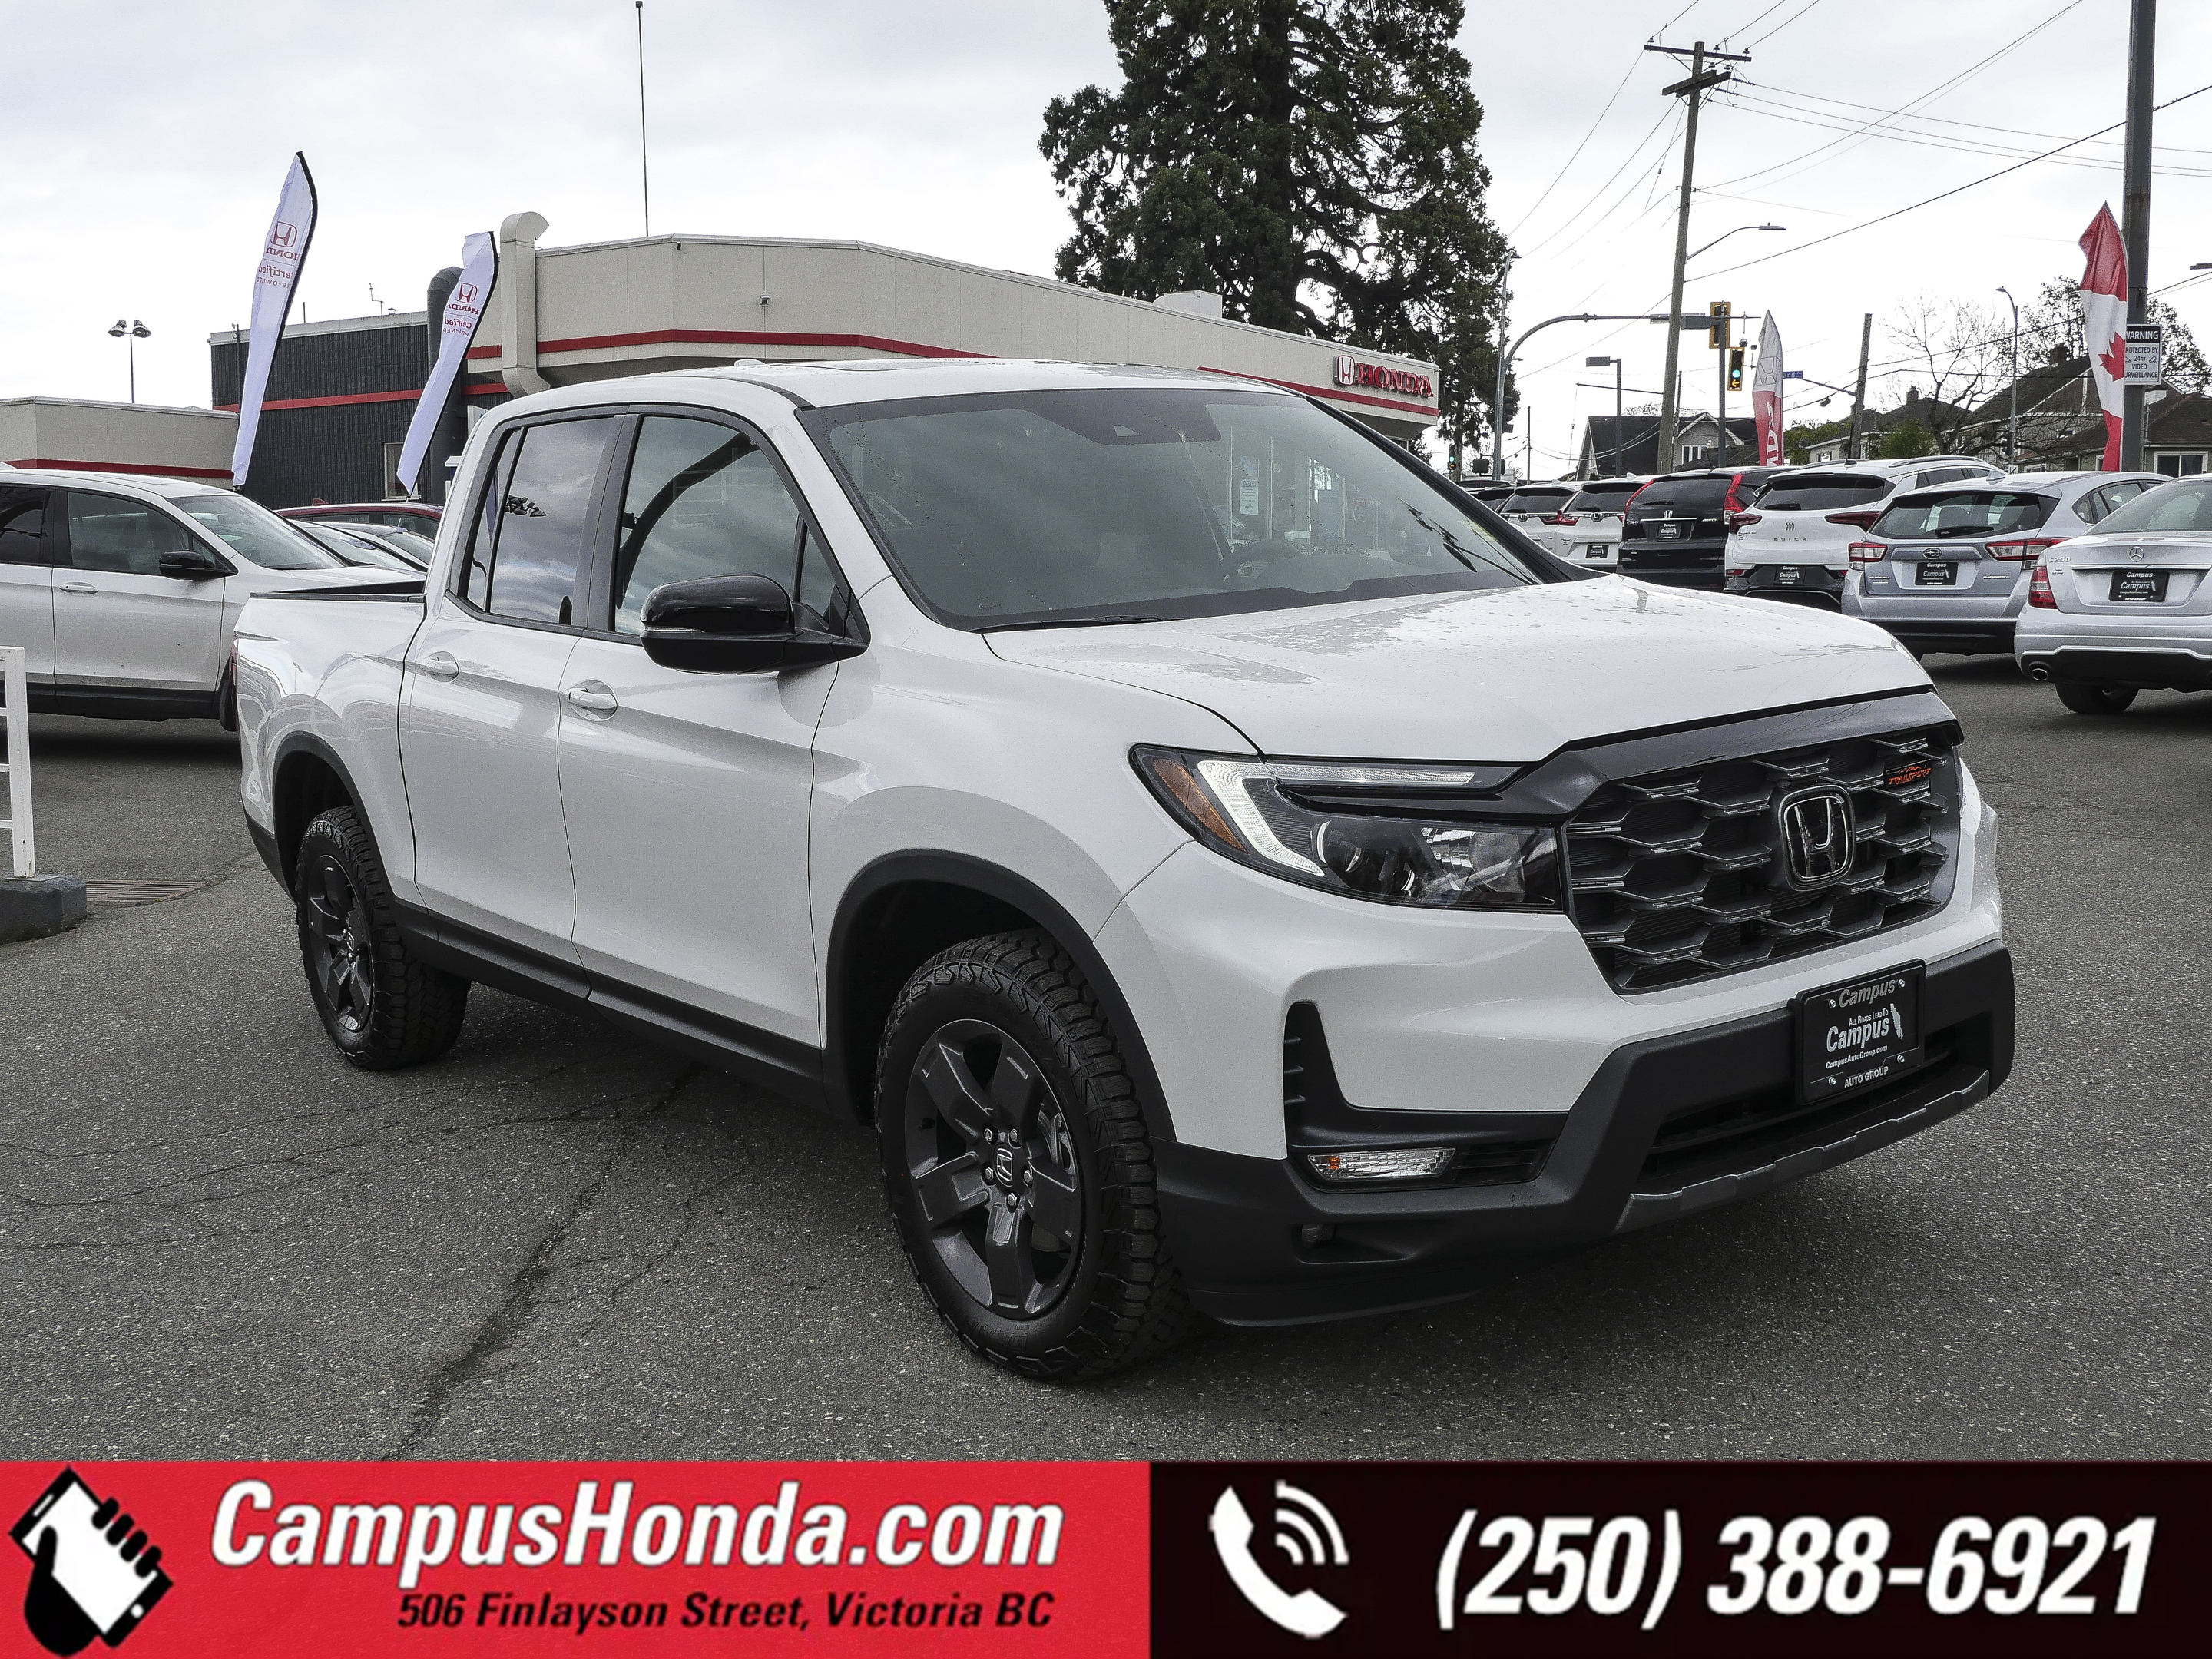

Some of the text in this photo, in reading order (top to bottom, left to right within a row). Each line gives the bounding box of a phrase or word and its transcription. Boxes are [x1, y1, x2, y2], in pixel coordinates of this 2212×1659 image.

[1356, 362, 1434, 398] HONDA
[2121, 581, 2150, 591] Campus
[1888, 767, 1932, 785] TRAILSPORT
[1839, 979, 1896, 1008] Campus
[1826, 1018, 1889, 1052] Campus
[1826, 1045, 1888, 1069] CampusAutoGroup.com
[1844, 1065, 1889, 1088] AUTO GROUP
